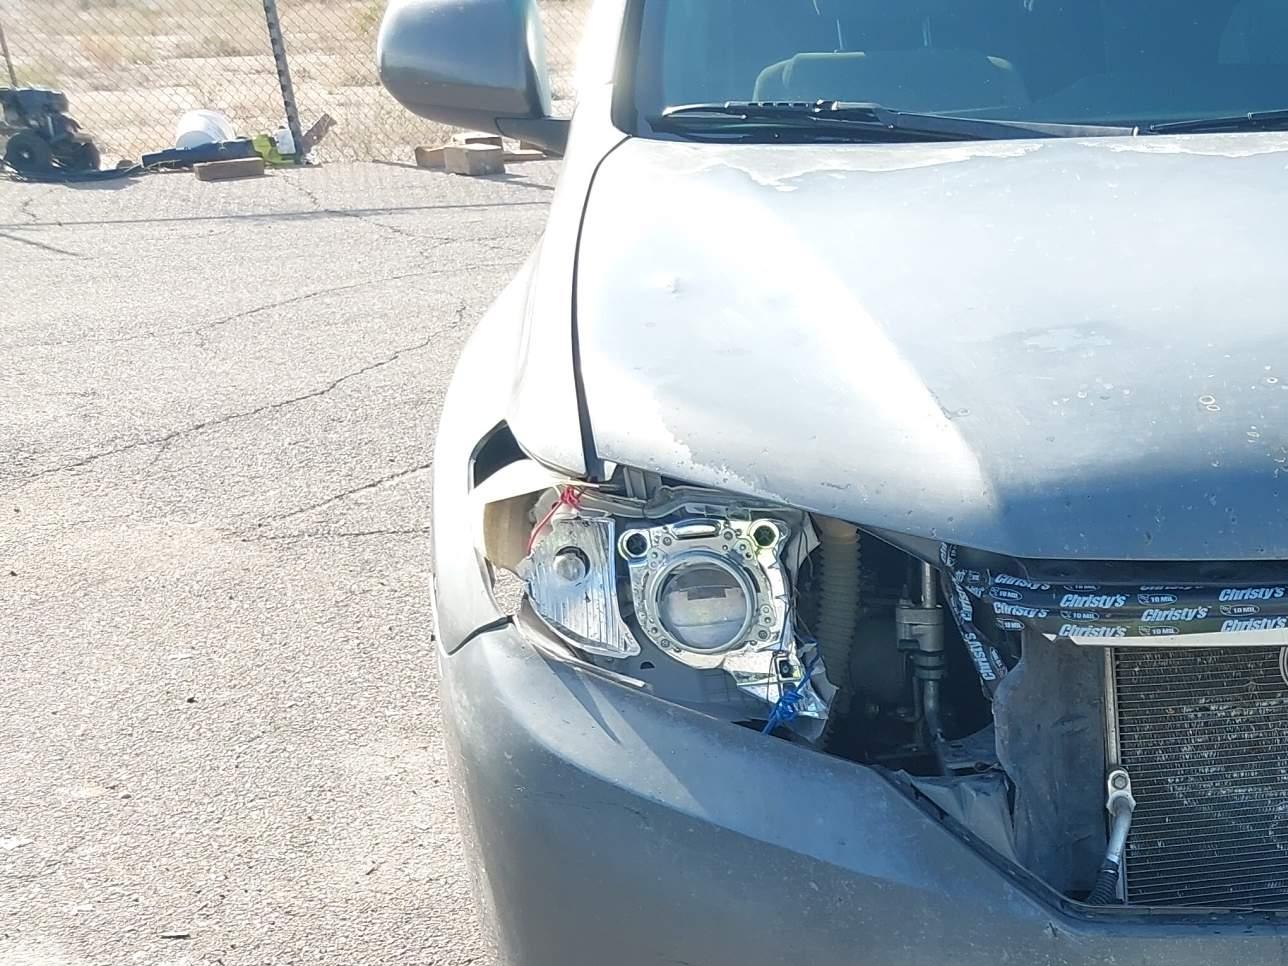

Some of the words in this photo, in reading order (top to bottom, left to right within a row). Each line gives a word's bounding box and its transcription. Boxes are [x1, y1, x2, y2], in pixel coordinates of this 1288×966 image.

[1060, 594, 1126, 609] Christy's
[1219, 587, 1285, 601] Christy's
[993, 602, 1049, 618] Christy's
[1141, 606, 1208, 621] Christy's
[1059, 624, 1126, 637] Christy's
[1220, 617, 1287, 633] Christy's
[965, 632, 996, 681] Christy's
